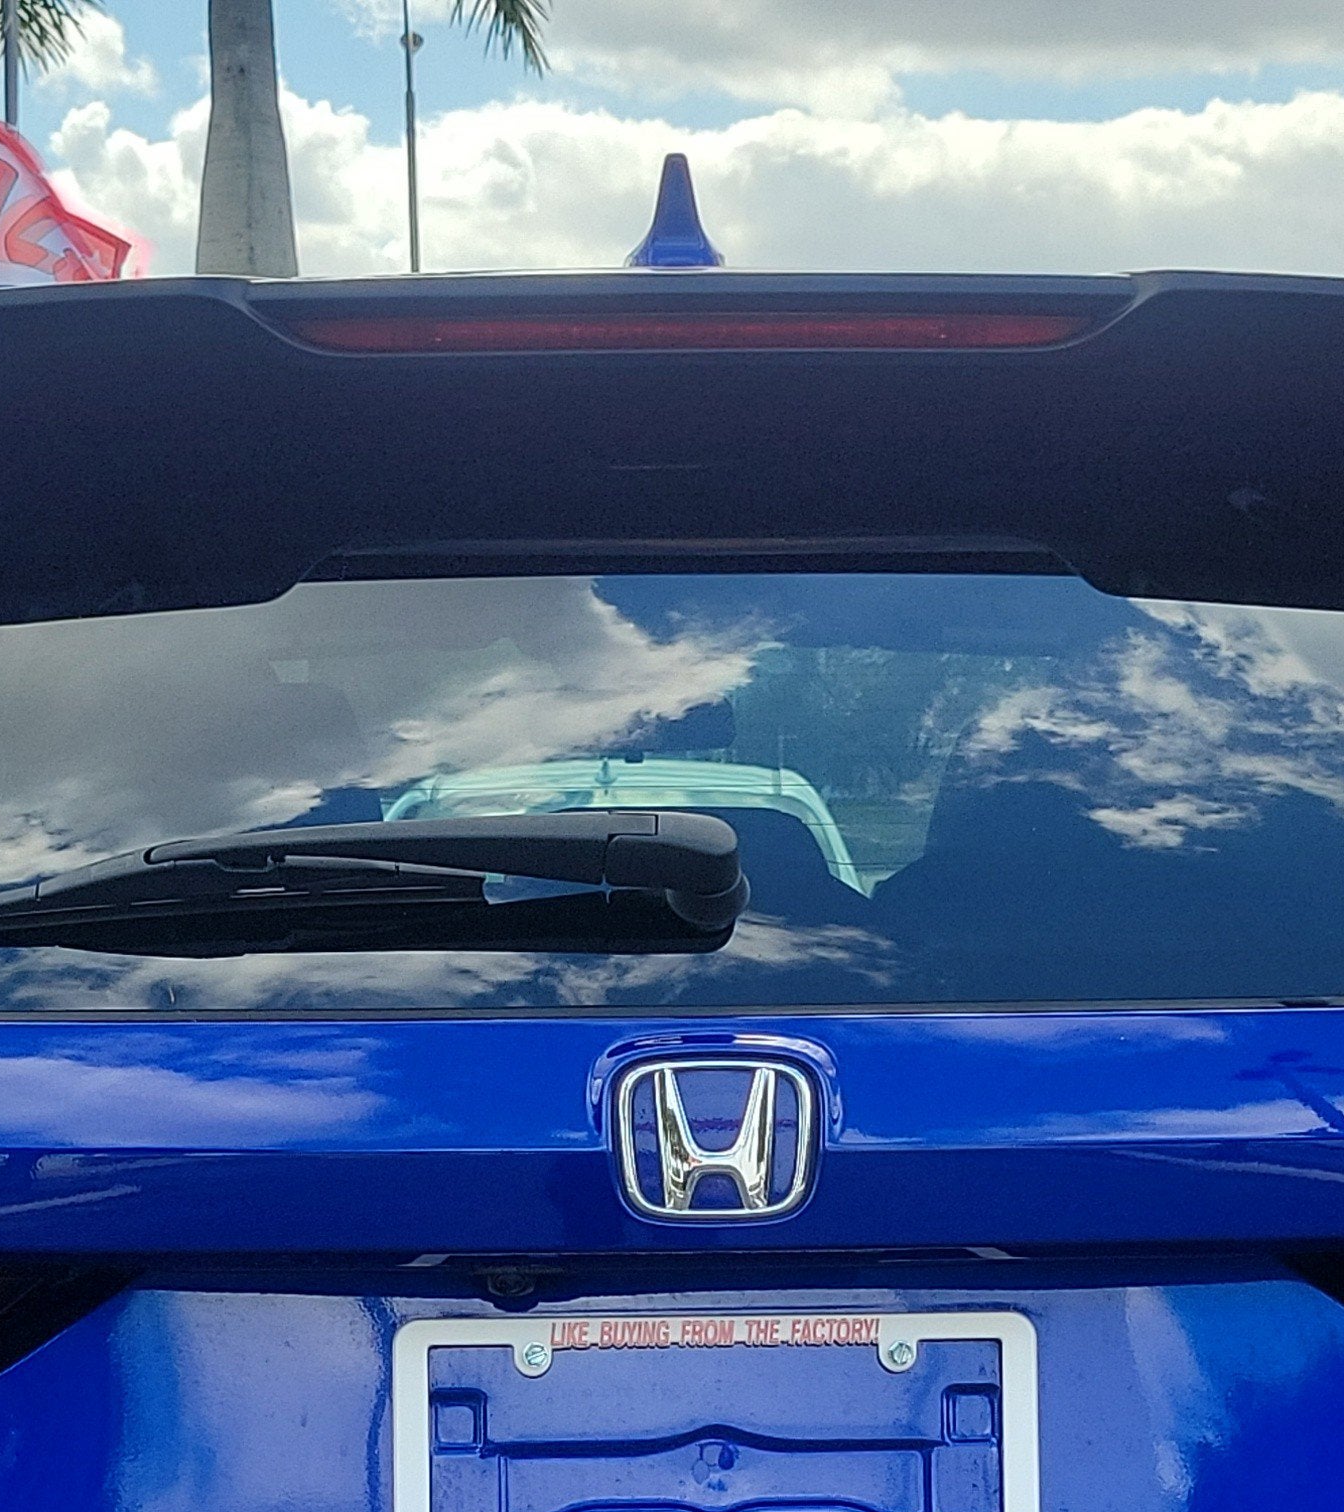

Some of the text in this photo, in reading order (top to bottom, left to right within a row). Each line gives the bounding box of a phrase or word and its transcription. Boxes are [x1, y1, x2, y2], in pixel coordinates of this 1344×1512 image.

[550, 1317, 880, 1346] LIKE BUYING FROM THE FACTORY!
